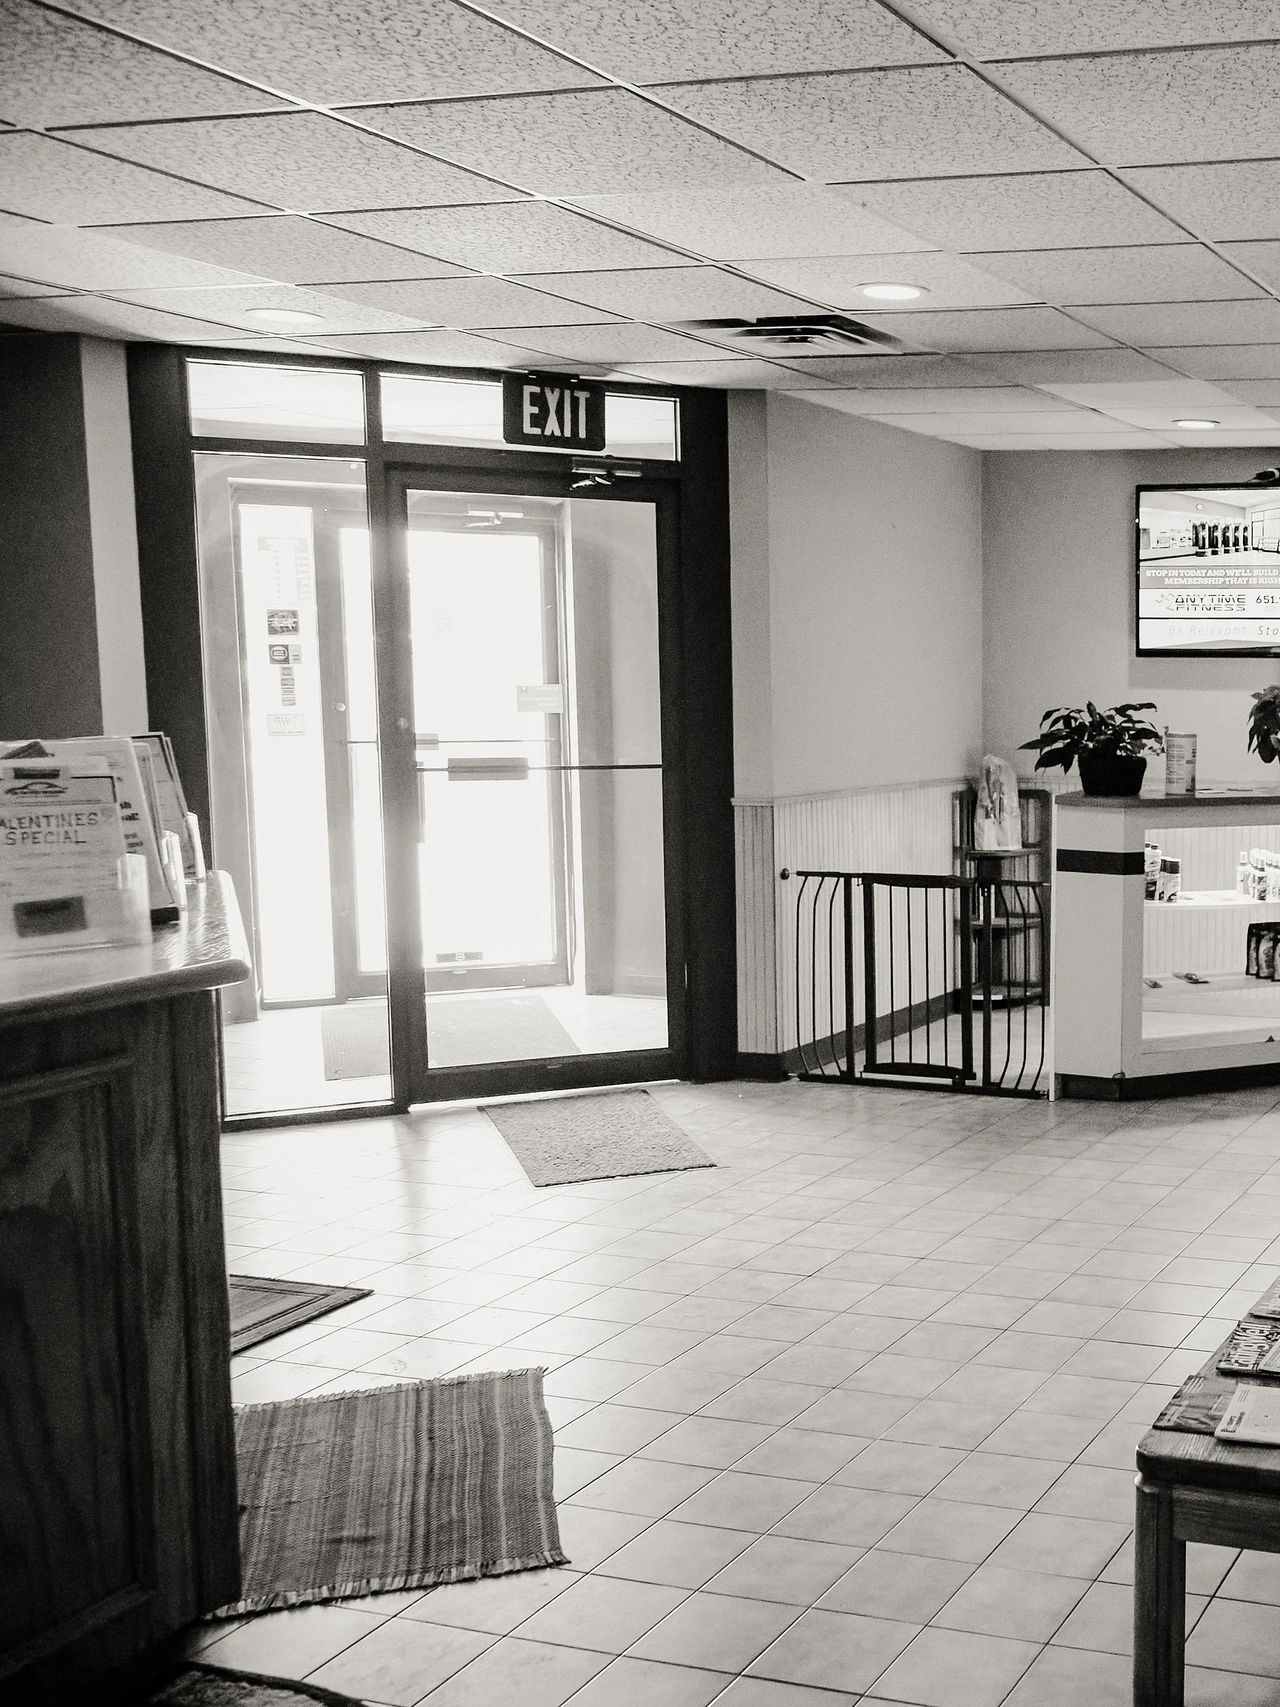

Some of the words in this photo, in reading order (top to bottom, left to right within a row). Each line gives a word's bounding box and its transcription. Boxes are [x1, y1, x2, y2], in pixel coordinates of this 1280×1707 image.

[523, 385, 591, 439] EXIT
[1146, 569, 1168, 577] STOP
[1168, 569, 1179, 577] IN
[1180, 569, 1206, 577] TODAY
[1207, 569, 1226, 577] AND
[1253, 569, 1279, 577] BUILD
[1165, 577, 1224, 585] MEMBERSHIP
[1225, 577, 1249, 585] THAT
[1249, 577, 1258, 585] IS
[1175, 594, 1246, 603] ANYTIME
[6, 830, 87, 846] SPECIAL
